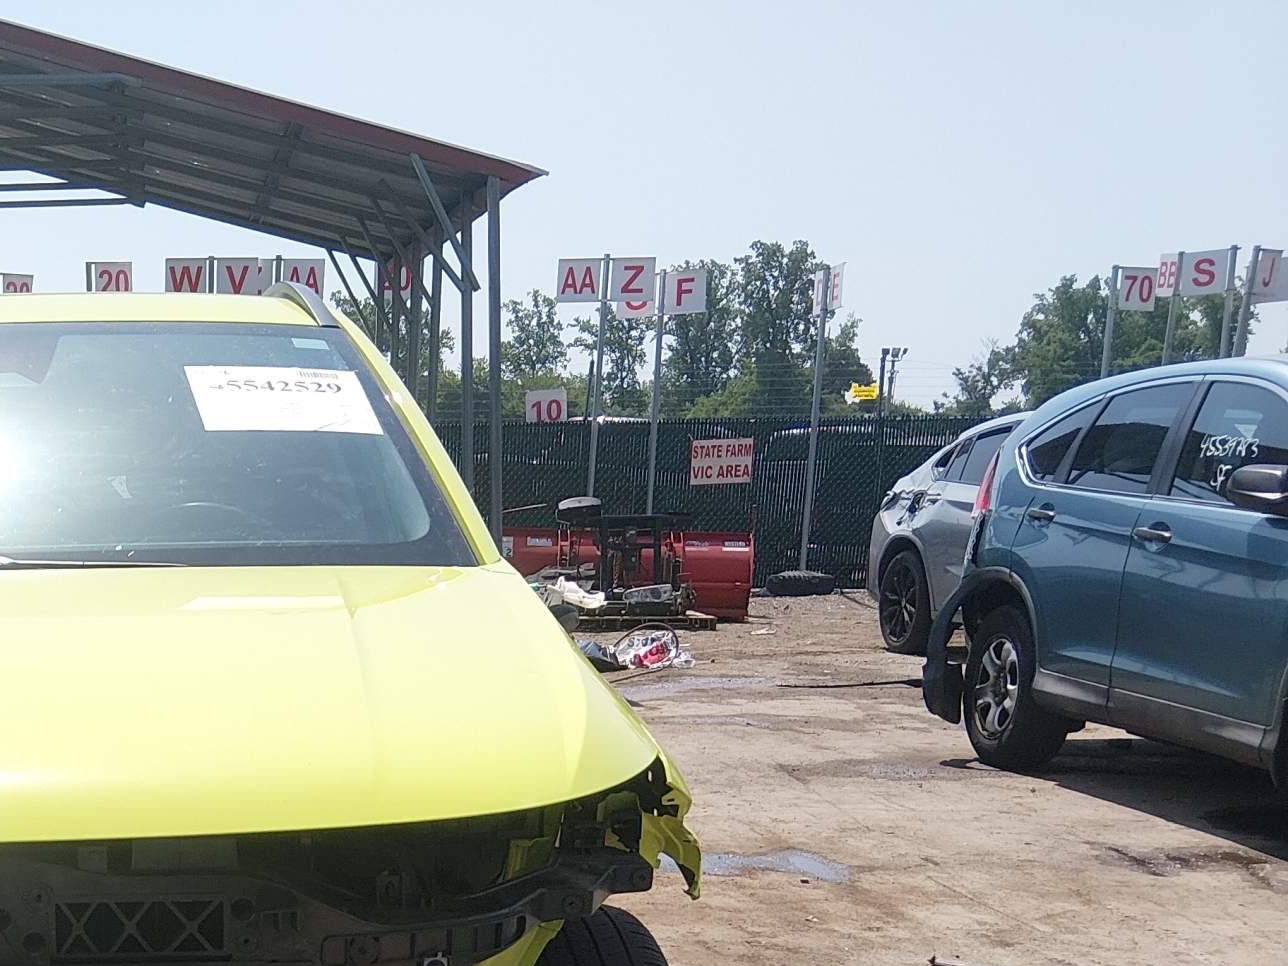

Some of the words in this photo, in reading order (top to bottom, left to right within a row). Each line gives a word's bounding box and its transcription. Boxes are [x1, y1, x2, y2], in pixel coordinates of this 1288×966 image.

[99, 269, 130, 292] 20
[169, 265, 203, 292] W
[225, 265, 249, 294] V
[561, 266, 595, 294] AA
[621, 265, 644, 293] Z
[1192, 258, 1215, 287] S
[1262, 256, 1276, 287] J
[675, 277, 695, 306] F
[831, 271, 840, 301] E
[1124, 275, 1153, 303] 70
[531, 399, 562, 421] 10
[693, 445, 723, 460] STATE
[725, 443, 752, 458] FARM
[692, 465, 713, 479] VIC
[717, 464, 750, 479] AREA
